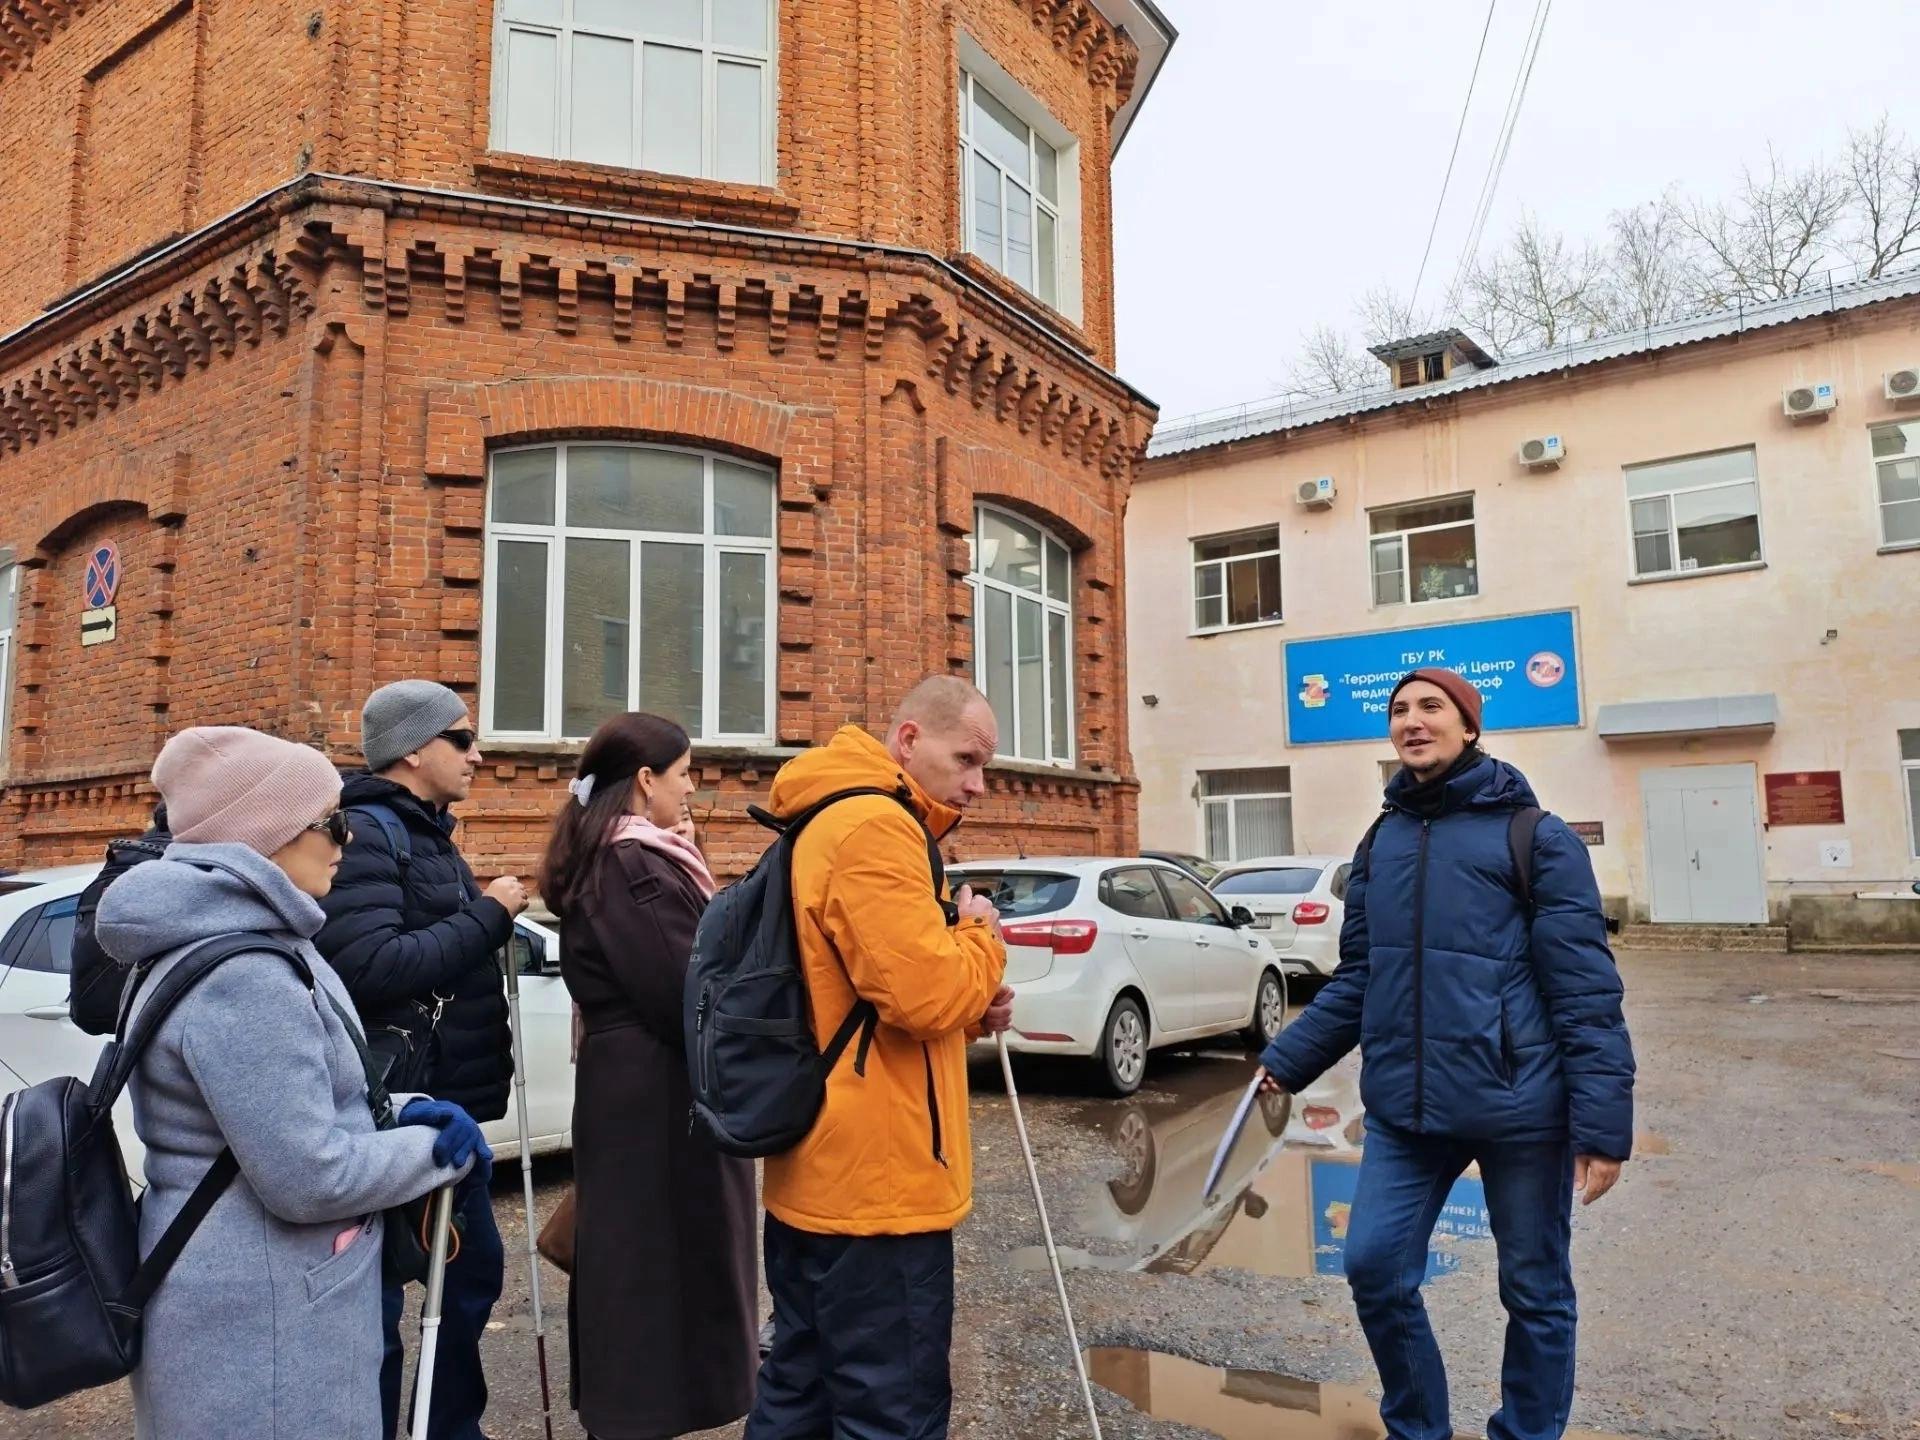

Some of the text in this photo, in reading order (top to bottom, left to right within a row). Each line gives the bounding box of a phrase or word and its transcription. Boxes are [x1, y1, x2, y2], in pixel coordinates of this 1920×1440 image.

[1401, 649, 1445, 664] ГБУ РК
[1470, 659, 1516, 673] Центр
